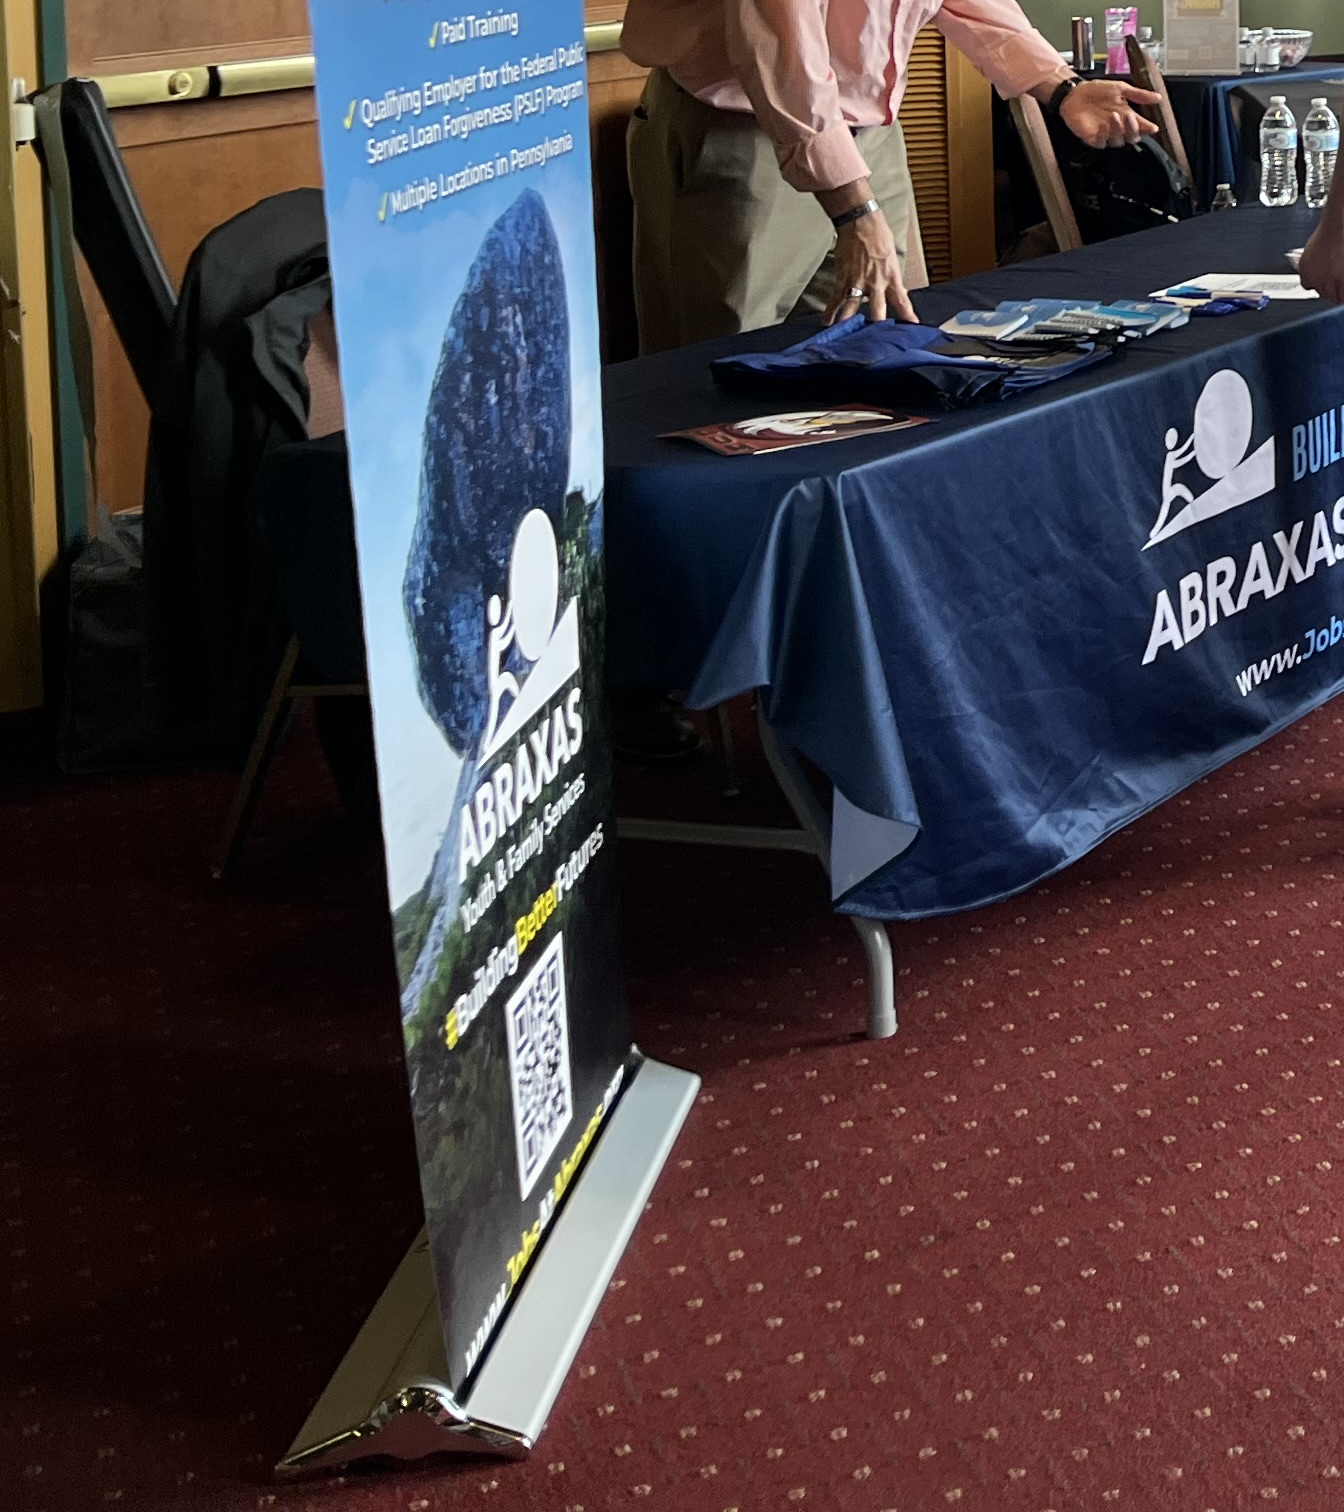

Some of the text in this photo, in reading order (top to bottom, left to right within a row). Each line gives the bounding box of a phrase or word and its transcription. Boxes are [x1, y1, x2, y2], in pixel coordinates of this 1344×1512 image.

[441, 9, 518, 45] Paid Training
[361, 41, 584, 128] Qualifying Employer for the Federal Public
[367, 80, 584, 164] Service Loan Forgiveness (PSLF) Program
[390, 130, 573, 215] Multiple Locations in Pennsylvania
[459, 687, 583, 884] ABRAXAS
[460, 772, 586, 933] Youth & Family Services
